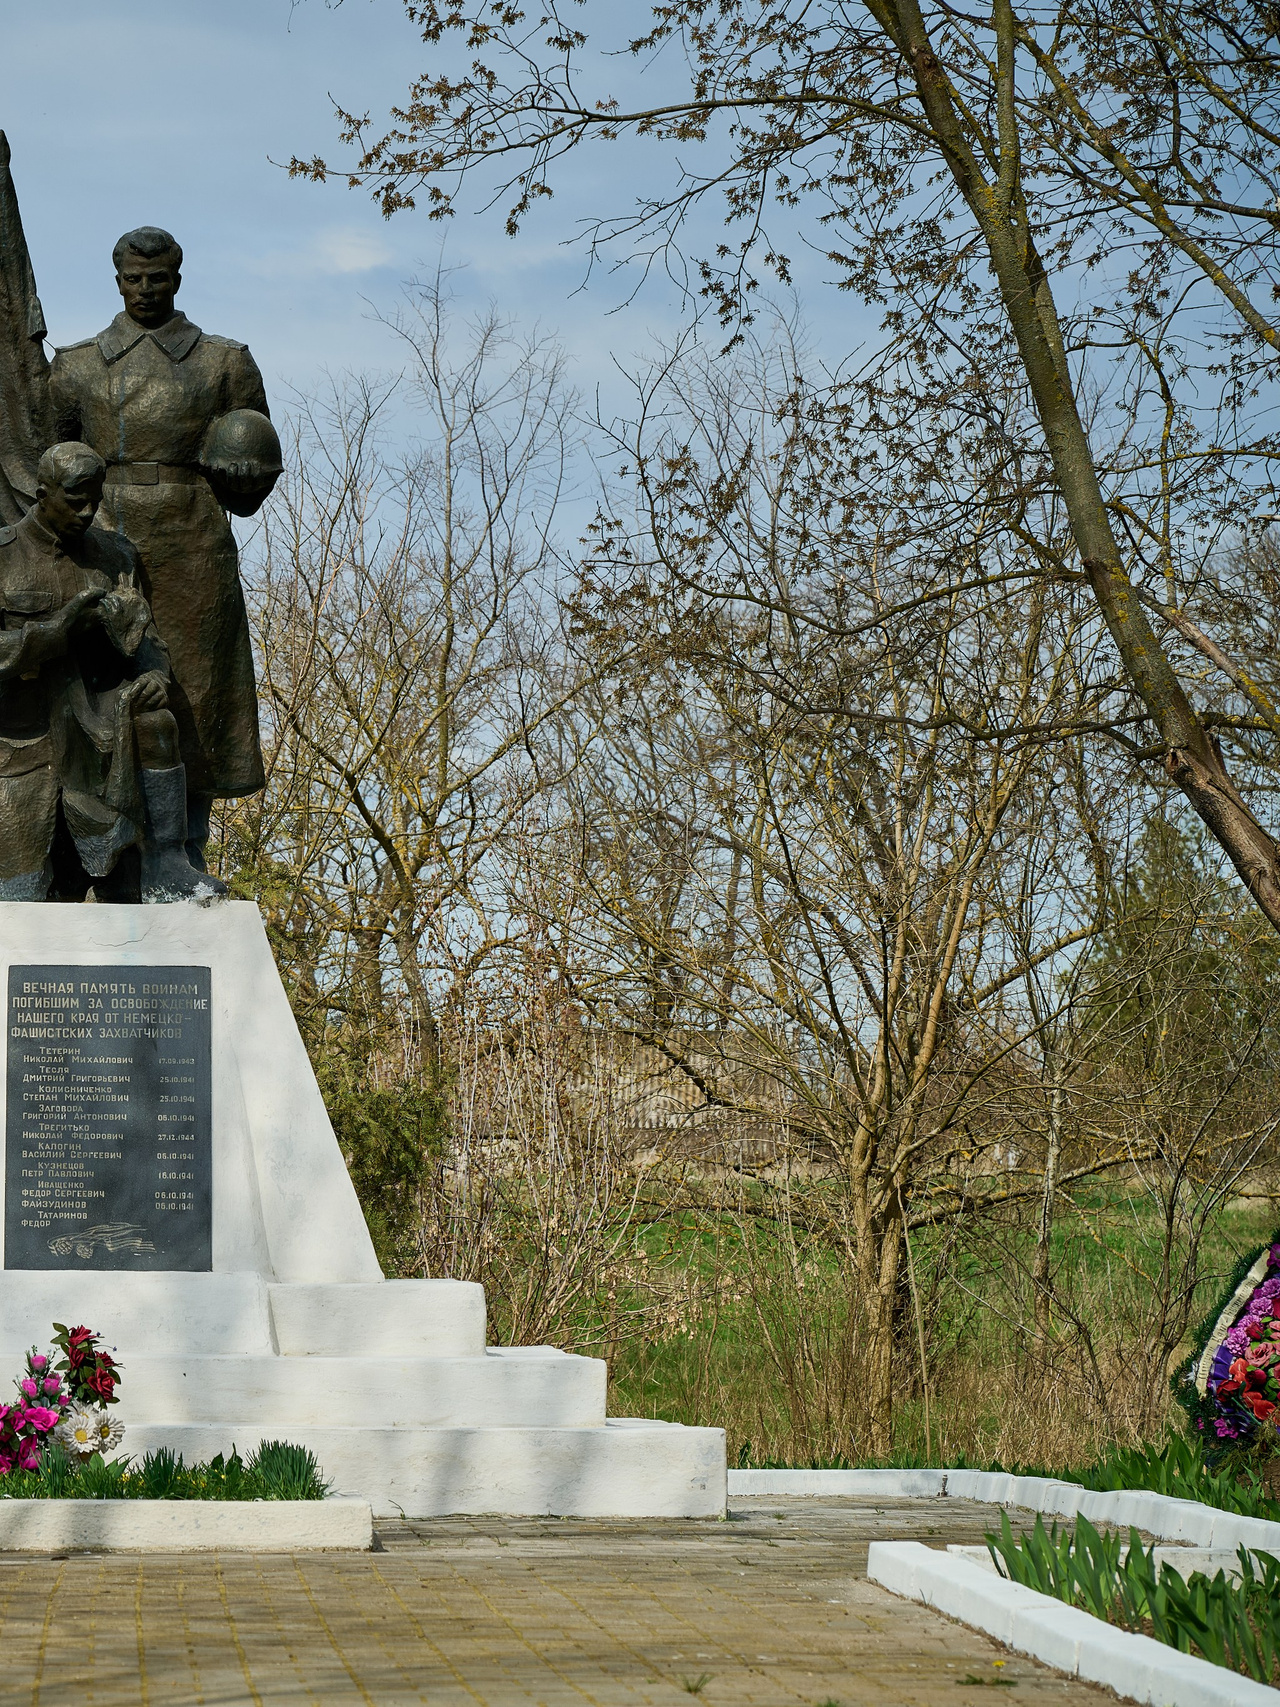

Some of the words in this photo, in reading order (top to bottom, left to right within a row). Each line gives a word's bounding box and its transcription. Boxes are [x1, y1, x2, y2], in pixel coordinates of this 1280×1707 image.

[24, 983, 74, 994] ВЕЧНАЯ
[81, 983, 135, 994] ПАМЯТЬ
[143, 985, 197, 994] ВОИНАМ
[13, 998, 79, 1008] ПОГИБШИМ
[89, 999, 103, 1008] ЗА
[112, 999, 207, 1011] ОСВОБОЖДЕНИЕ
[18, 1013, 64, 1023] НАШЕГО
[72, 1014, 98, 1023] КРАЯ
[105, 1014, 119, 1023] ОТ
[11, 1027, 92, 1038] ФАШИСТСКИХ
[100, 1028, 182, 1039] ЗАХВАТЧИКОВ
